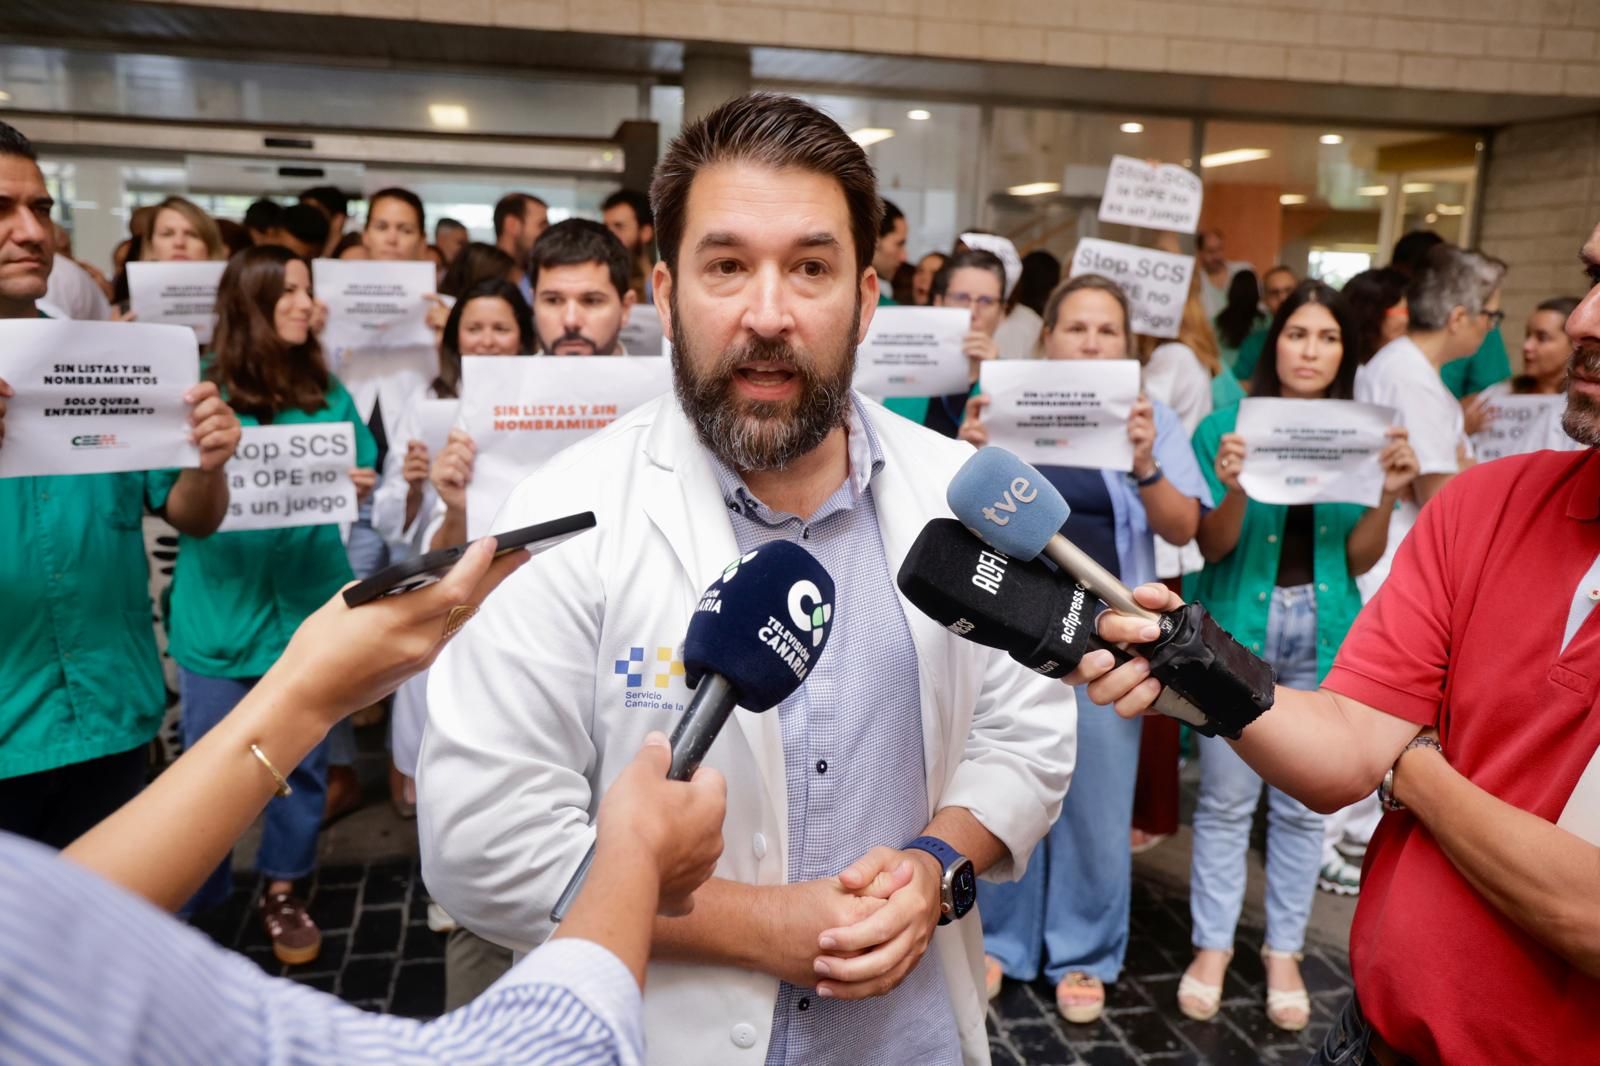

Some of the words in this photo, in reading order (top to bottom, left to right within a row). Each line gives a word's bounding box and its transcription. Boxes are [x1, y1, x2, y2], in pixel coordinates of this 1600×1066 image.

[1079, 248, 1129, 275] Stop
[1135, 259, 1185, 284] SCS
[1147, 291, 1171, 305] no
[53, 364, 75, 373] SIN
[78, 364, 119, 373] LISTAS
[122, 365, 129, 373] Y
[132, 365, 152, 374] SIN
[43, 376, 158, 385] NOMBRAMIENTOS
[64, 397, 97, 406] SOLO
[99, 397, 140, 407] QUEDA
[43, 408, 155, 417] ENFRENTAMIENTO
[494, 404, 519, 416] SIN
[523, 404, 576, 416] LISTAS
[579, 404, 588, 415] Y
[592, 404, 617, 415] SIN
[289, 433, 349, 459] SCS
[253, 468, 304, 488] OPE
[310, 469, 338, 484] no
[251, 501, 279, 515] un
[283, 495, 347, 517] juego
[982, 477, 1038, 526] tve
[767, 615, 811, 662] TELEVISIÓN
[758, 626, 808, 680] CANARIA
[625, 690, 662, 700] Servicio
[625, 700, 660, 709] Canario
[661, 702, 673, 710] de
[675, 703, 684, 711] la
